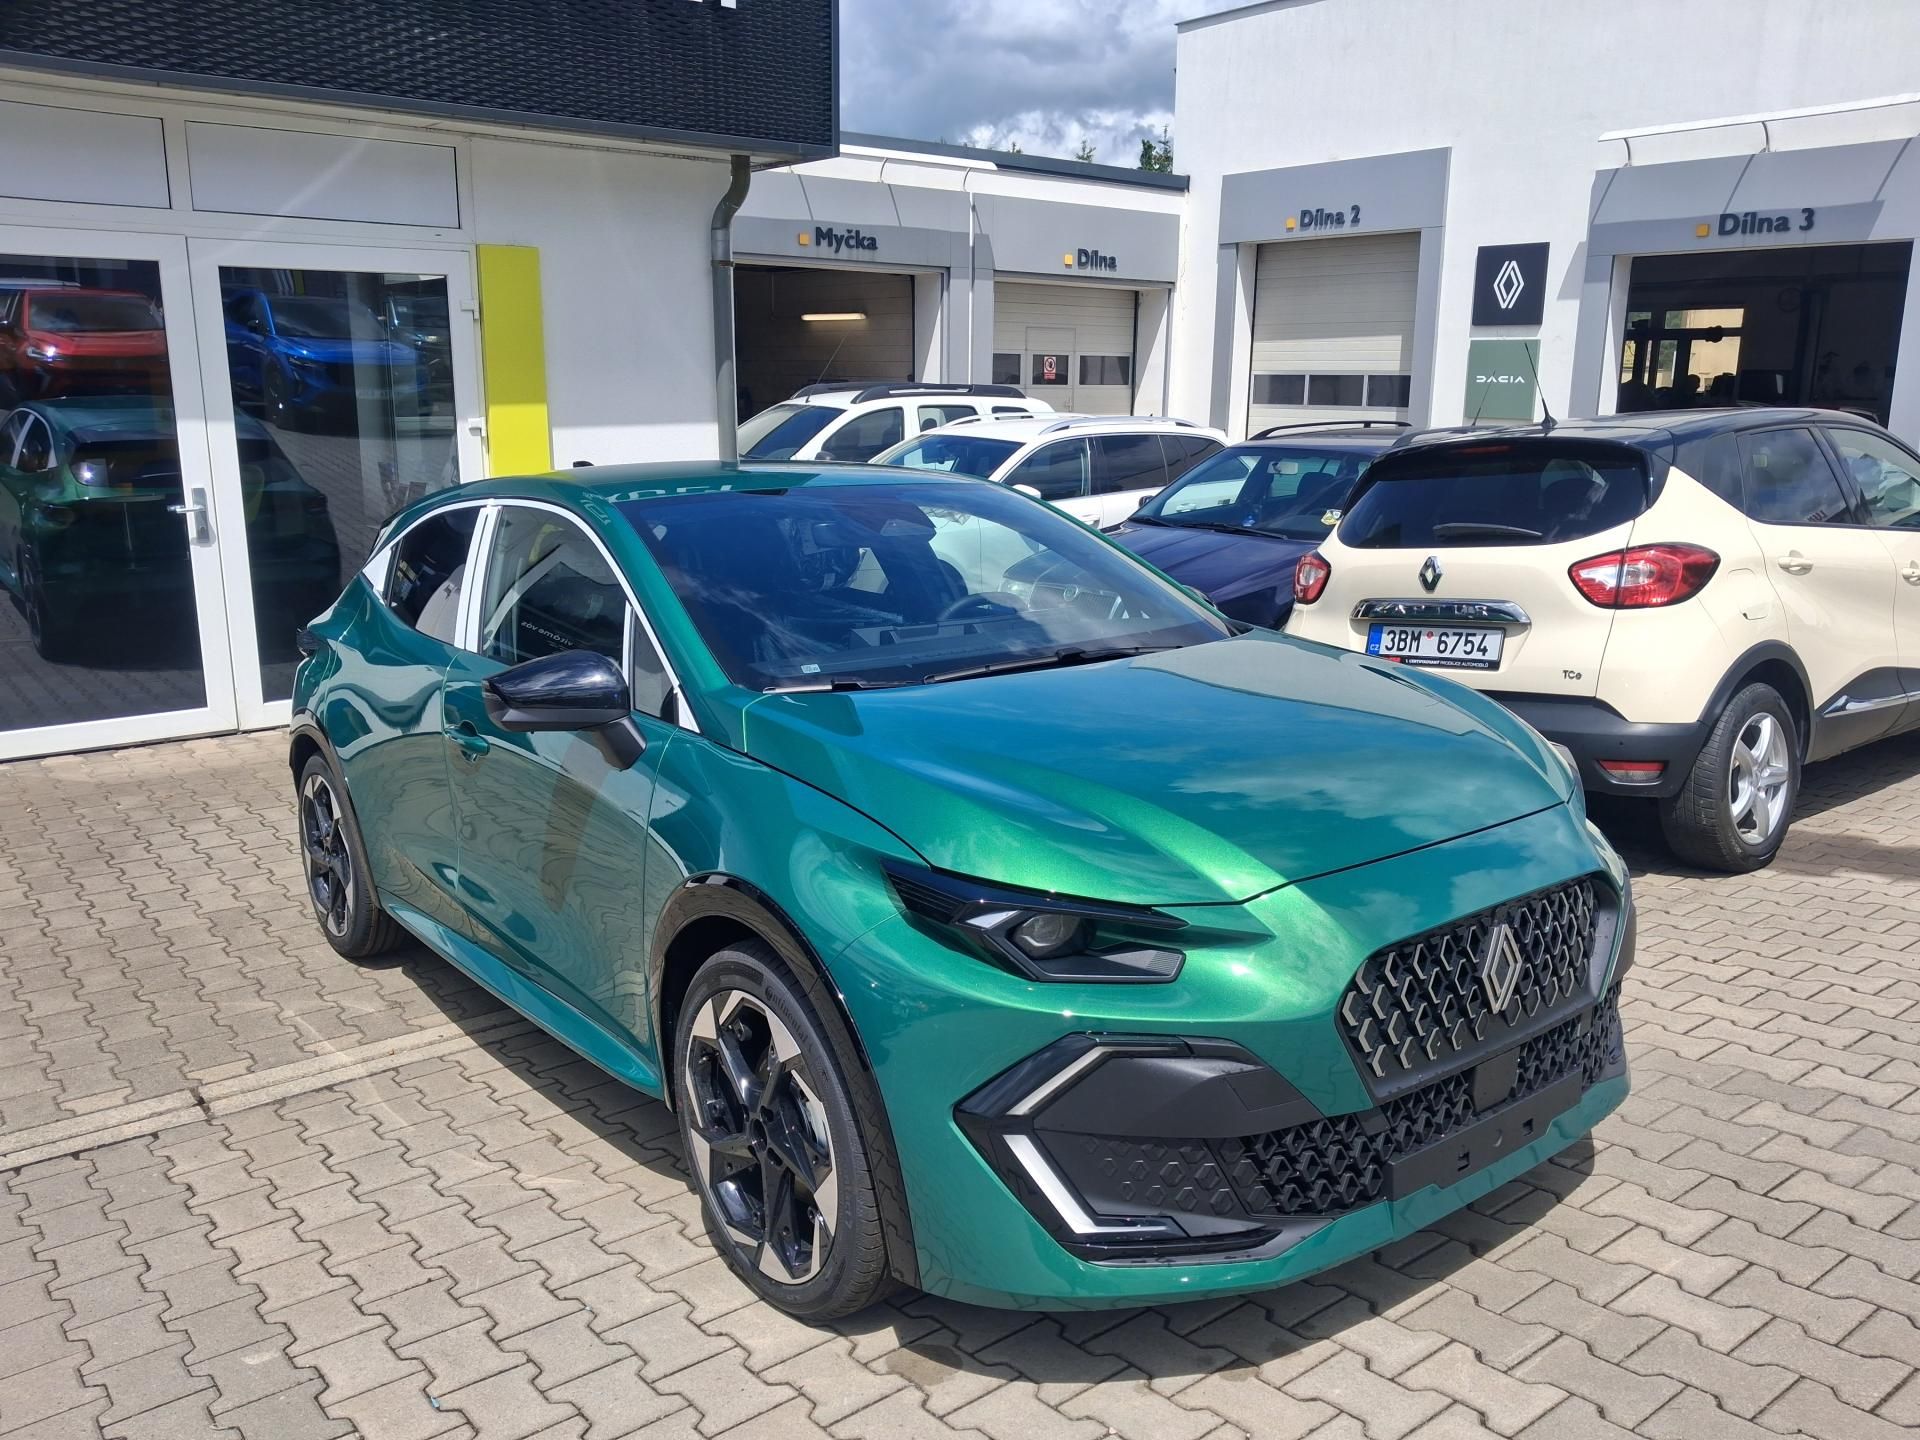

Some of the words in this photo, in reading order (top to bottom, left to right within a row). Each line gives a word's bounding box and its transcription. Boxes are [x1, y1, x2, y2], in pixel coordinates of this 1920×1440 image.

[1299, 208, 1345, 229] Dílna
[1350, 204, 1361, 224] 2
[1718, 211, 1791, 236] Dílna
[1798, 207, 1815, 231] 3
[815, 226, 878, 254] Myčka
[1077, 248, 1118, 270] Dílna
[1475, 375, 1525, 384] DACIA
[1369, 643, 1379, 651] CZ
[1385, 629, 1422, 653] 3BM
[1436, 631, 1489, 657] 6754
